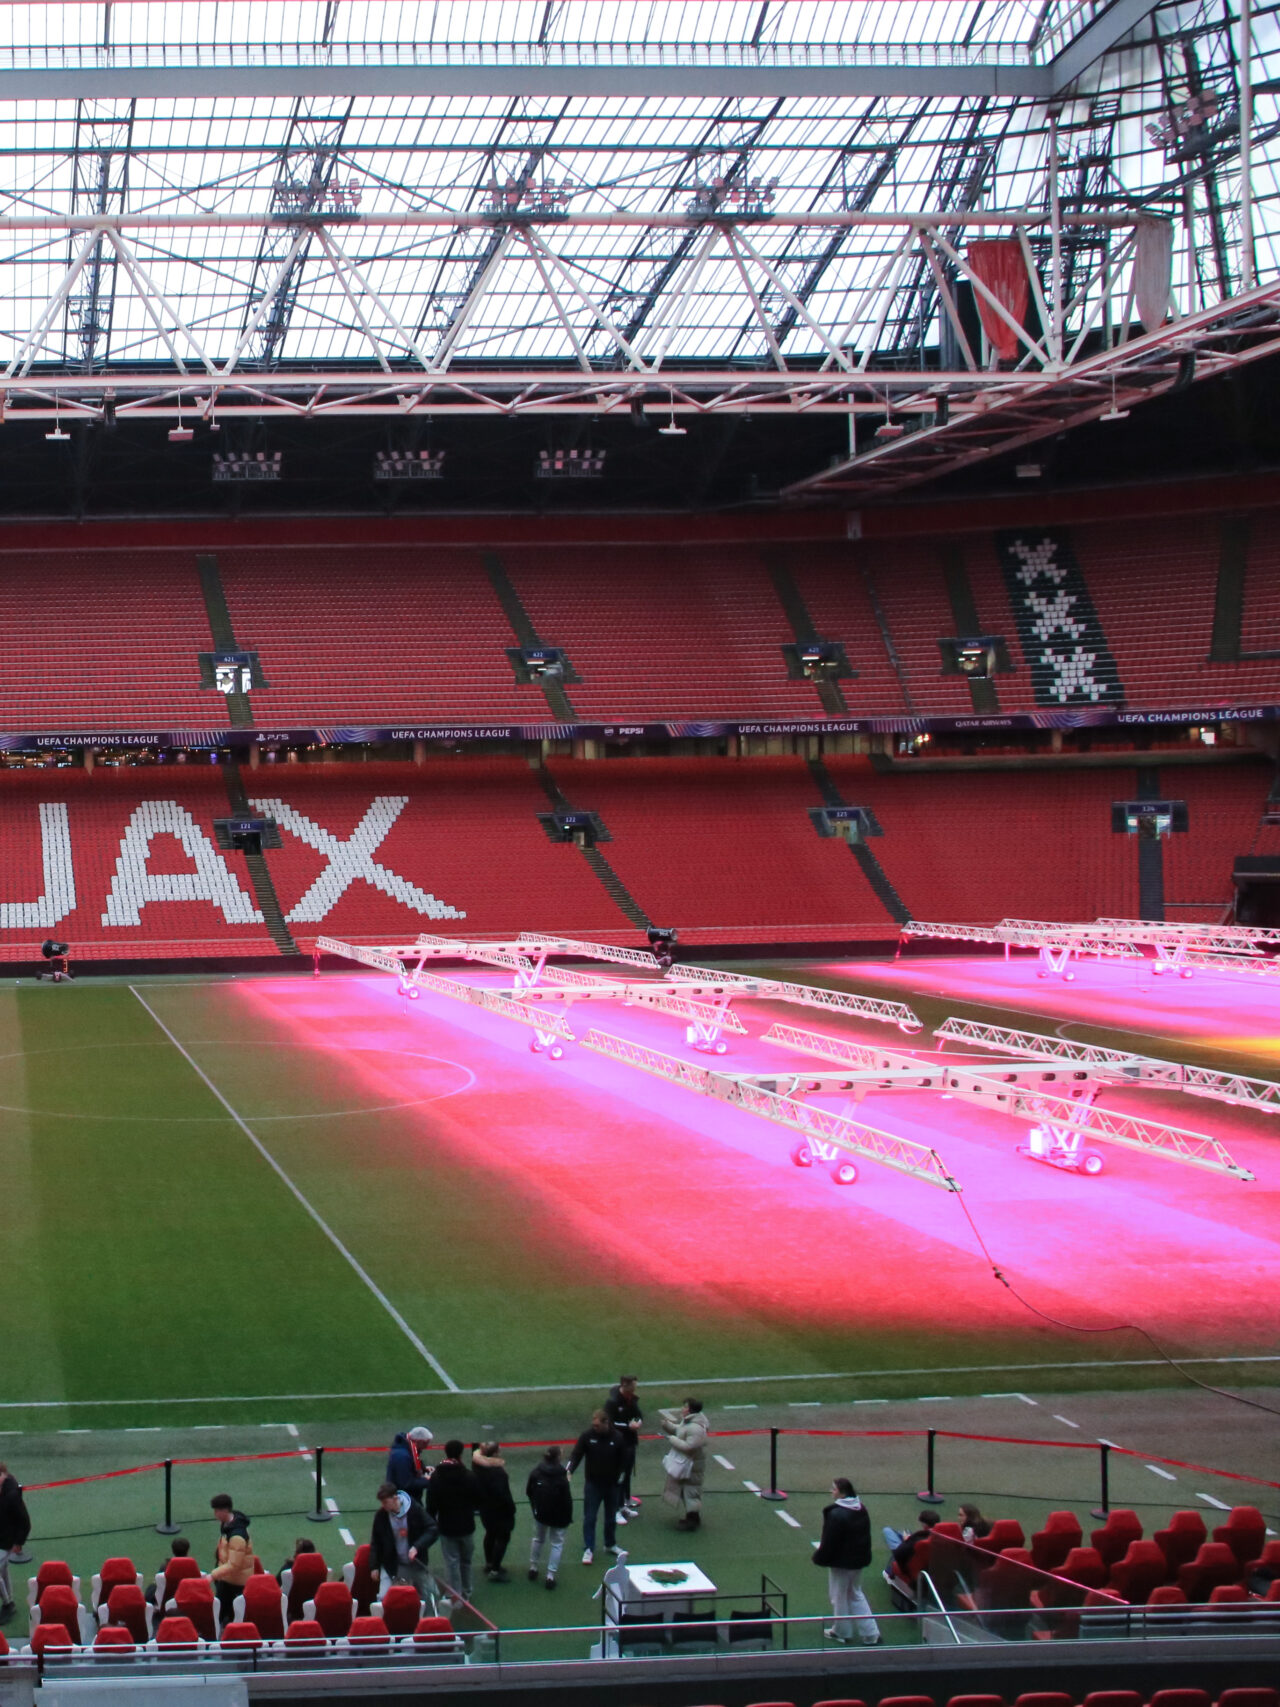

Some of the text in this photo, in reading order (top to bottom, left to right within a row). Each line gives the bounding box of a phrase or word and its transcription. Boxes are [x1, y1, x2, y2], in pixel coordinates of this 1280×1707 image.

[1117, 709, 1263, 723] UEFA CHAMPIONS LEAGUE
[738, 722, 858, 733] UEFA CHAMPIONS LEAGUE
[955, 719, 980, 728] QATAR
[391, 728, 511, 738] UEFA CHAMPIONS LEAGUE
[619, 727, 644, 735] PEPSI
[37, 735, 159, 745] UEFA CHAMPIONS LEAGUE
